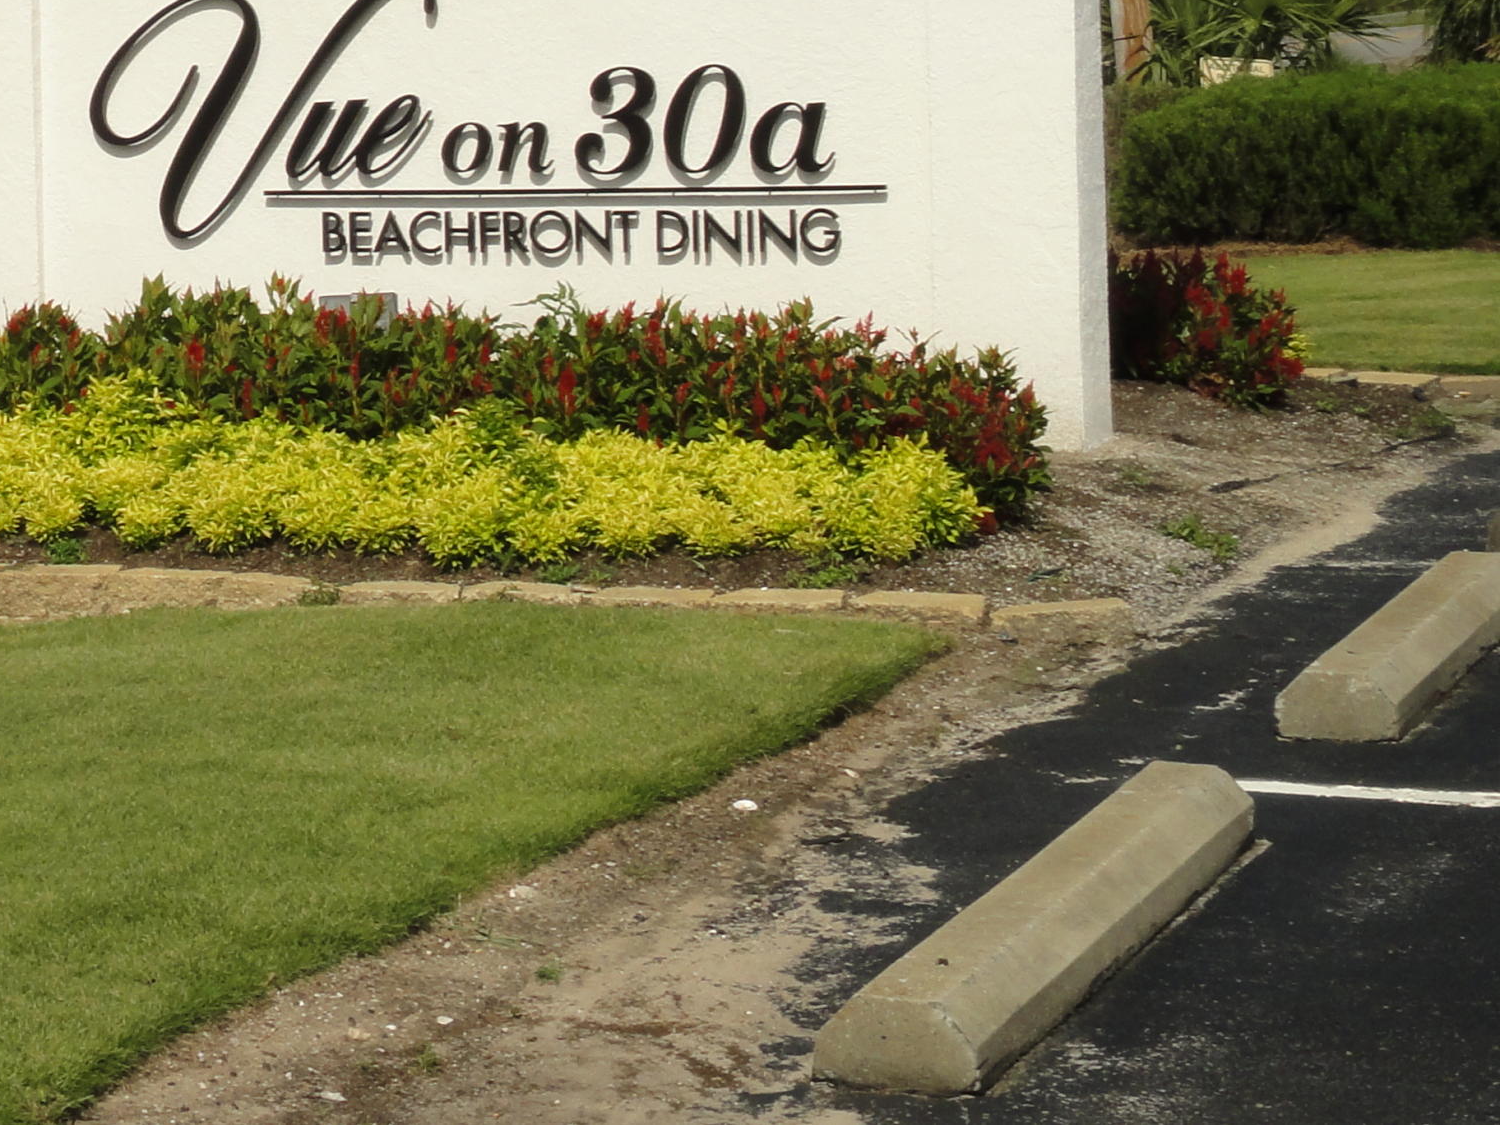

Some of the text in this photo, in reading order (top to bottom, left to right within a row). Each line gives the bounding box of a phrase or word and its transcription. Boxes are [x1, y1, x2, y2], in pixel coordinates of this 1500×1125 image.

[440, 120, 554, 174] on
[574, 63, 836, 177] 30a
[320, 208, 843, 255] BEACHFRONT DINING
